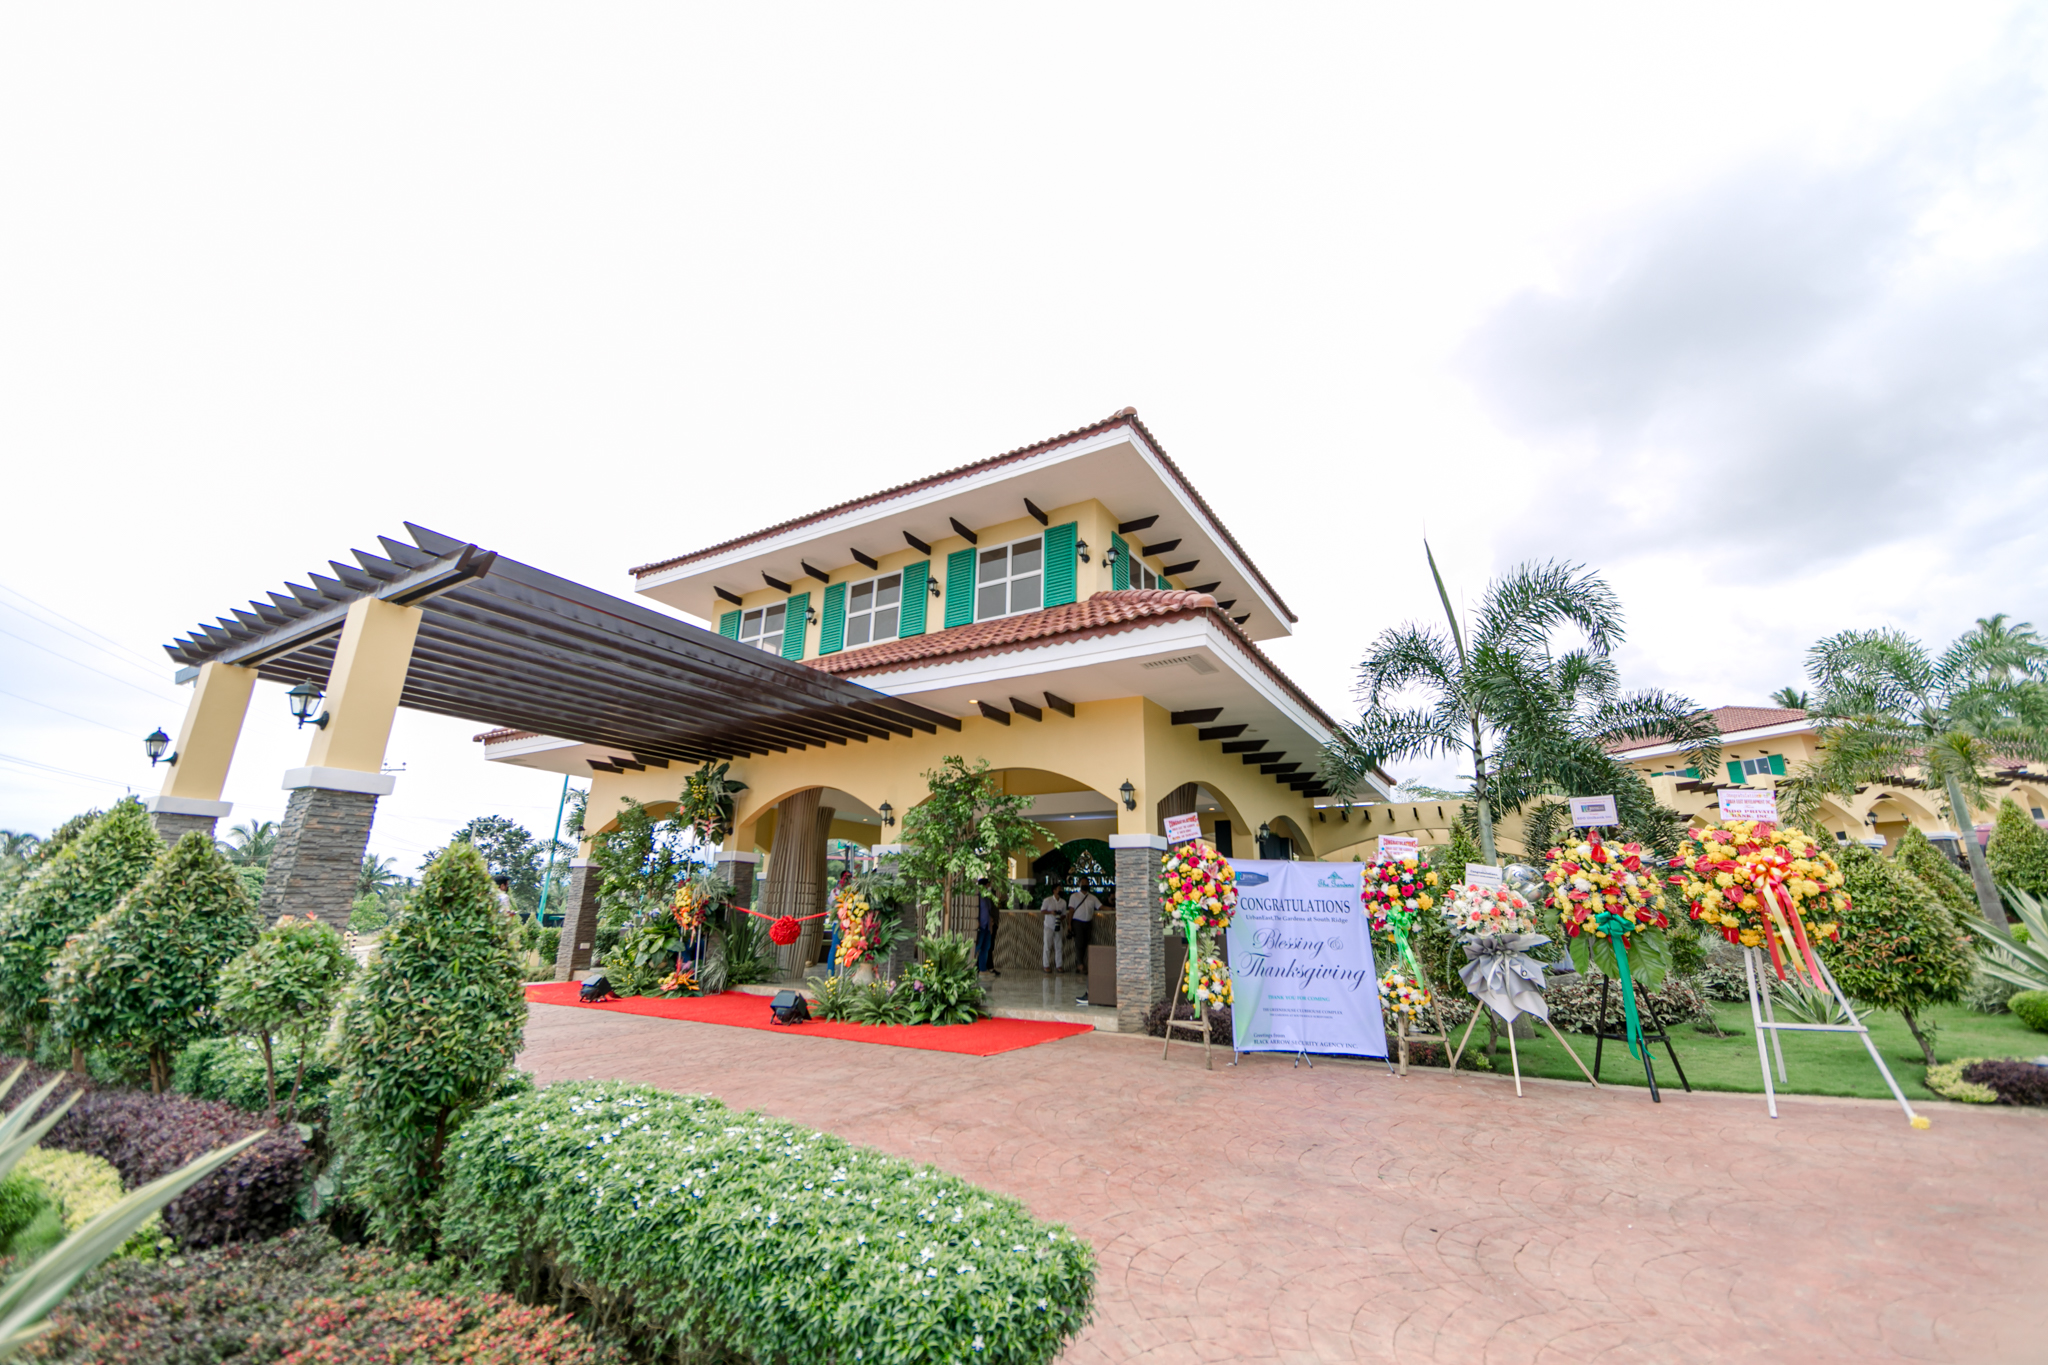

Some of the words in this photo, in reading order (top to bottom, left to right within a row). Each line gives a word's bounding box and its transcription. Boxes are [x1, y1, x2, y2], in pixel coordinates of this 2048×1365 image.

[1240, 897, 1350, 914] CONGRATULATIONS
[1252, 928, 1324, 960] Blessing
[1237, 951, 1367, 992] Thanksgiving
